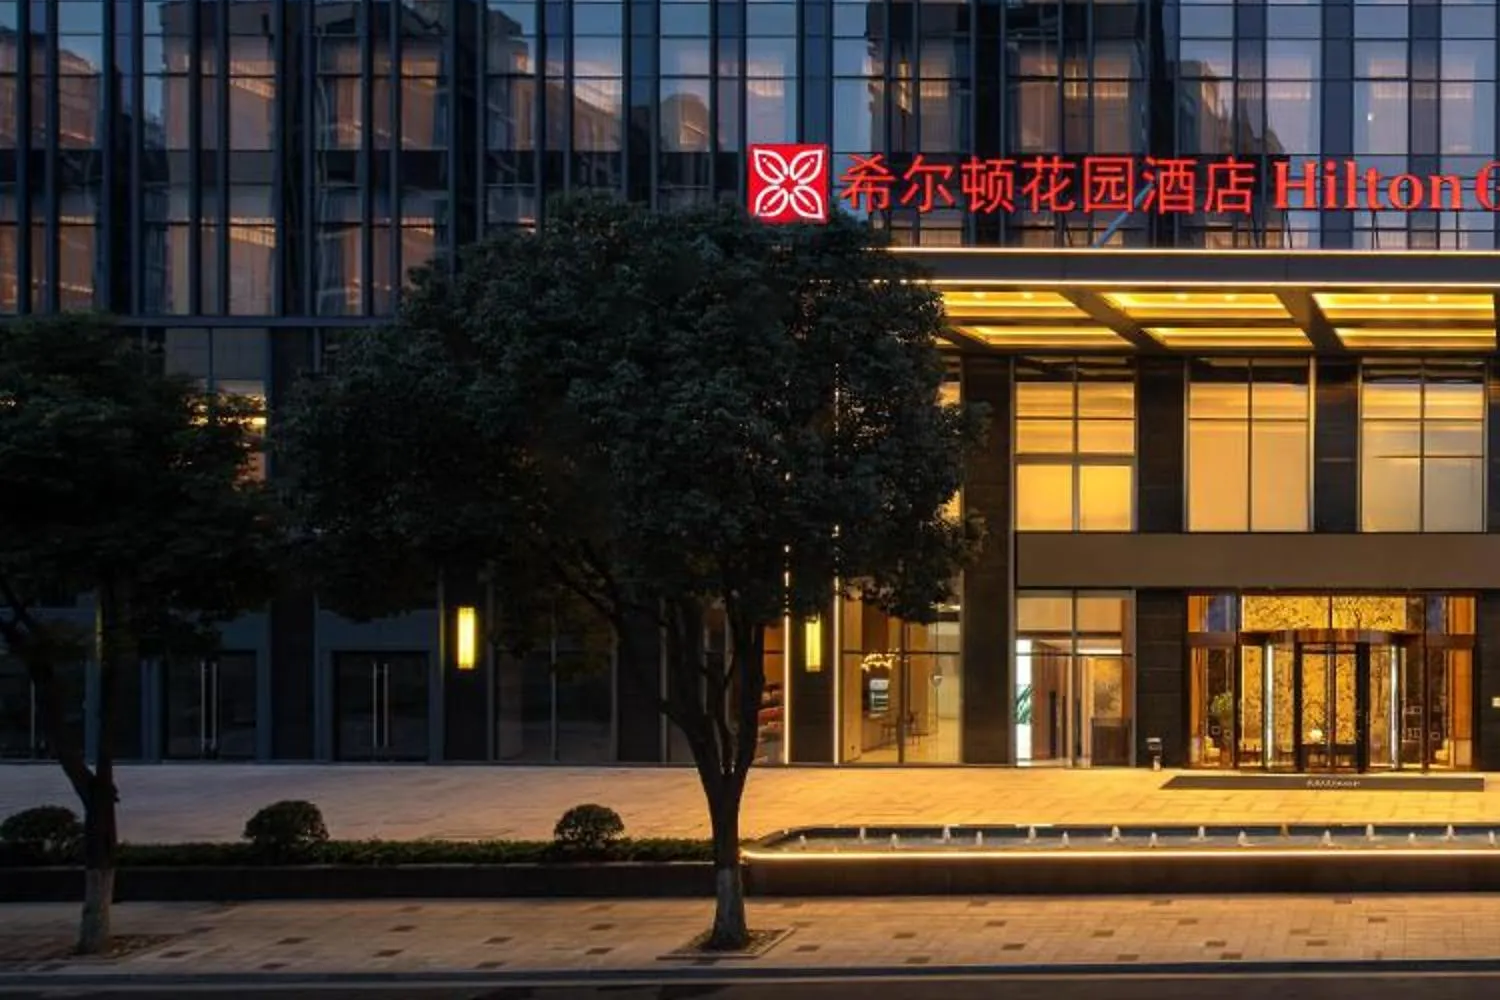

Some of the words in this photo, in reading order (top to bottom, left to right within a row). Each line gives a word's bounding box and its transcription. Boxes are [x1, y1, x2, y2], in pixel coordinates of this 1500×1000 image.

[839, 153, 1256, 214] 希尔顿花园酒店
[1273, 160, 1462, 210] Hilton
